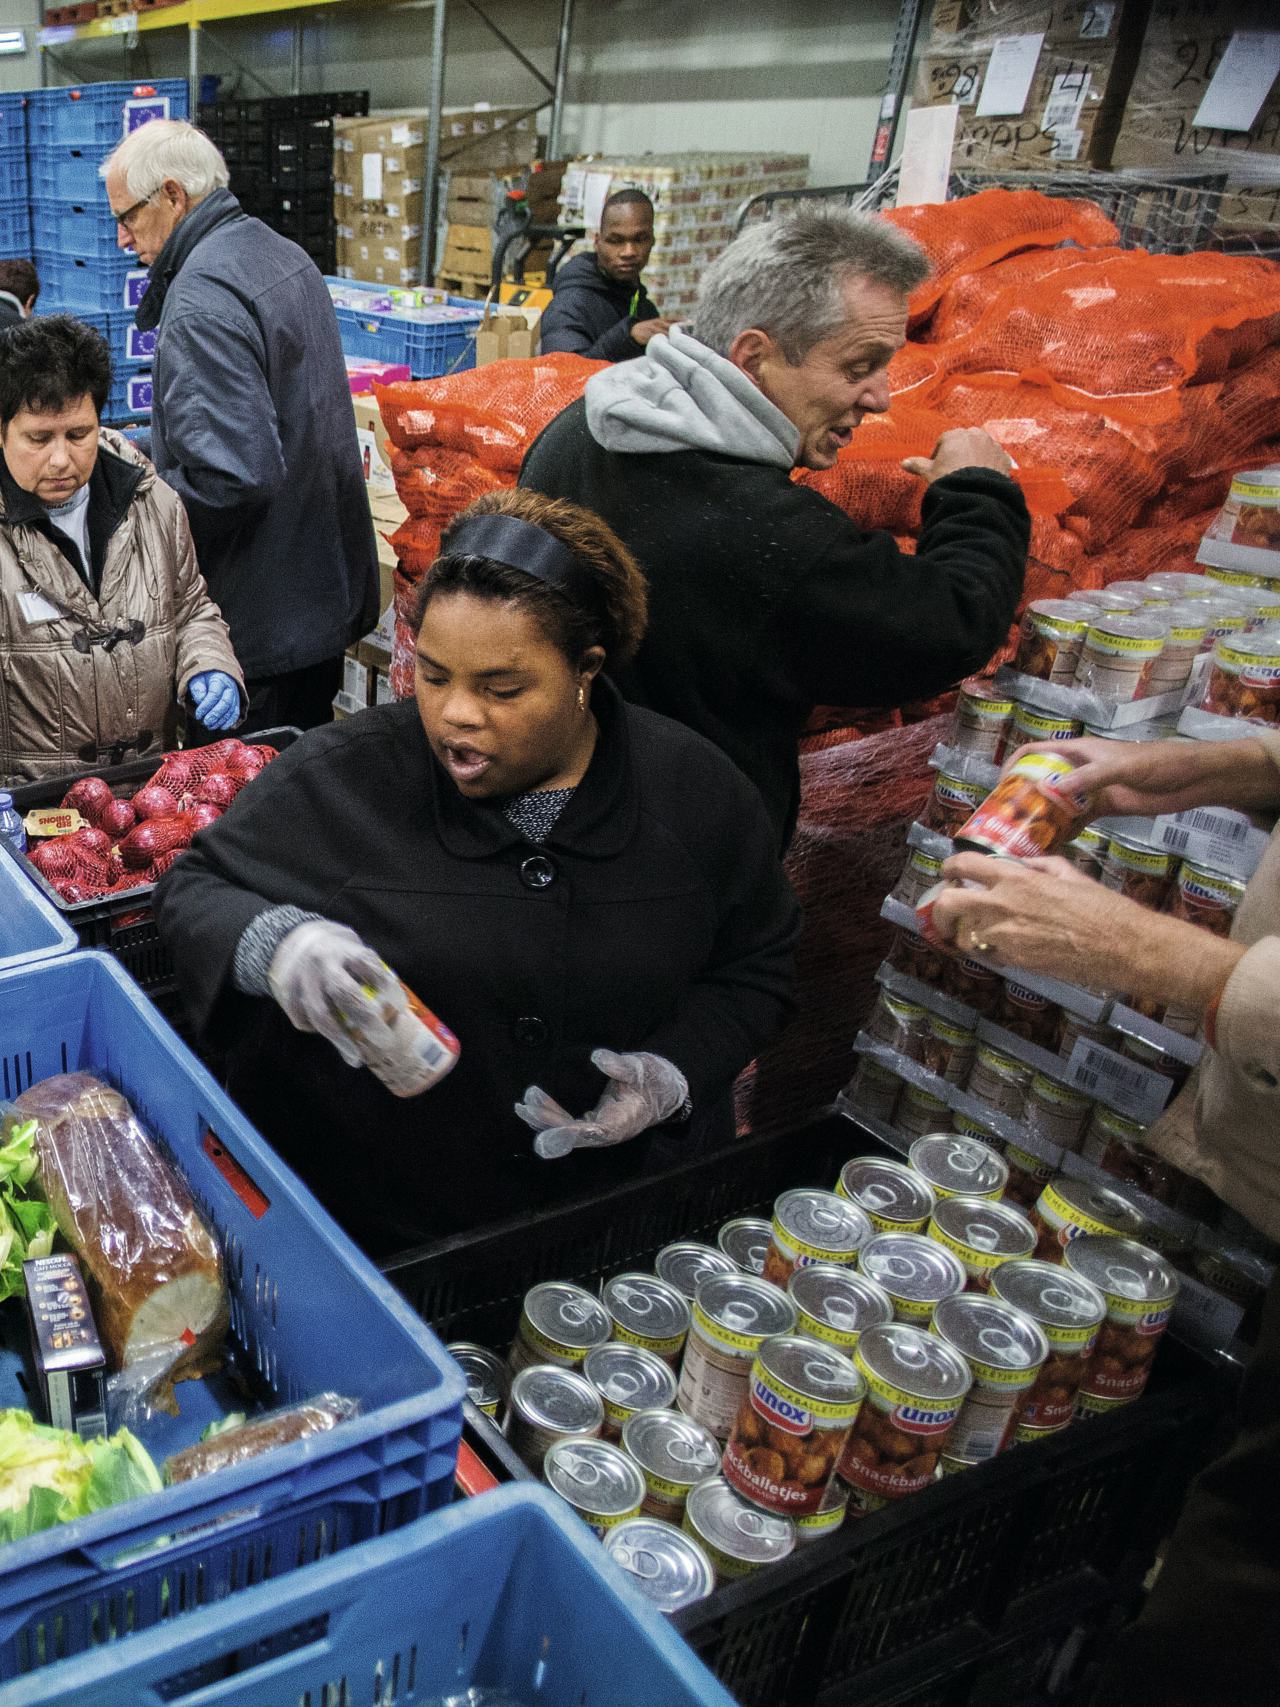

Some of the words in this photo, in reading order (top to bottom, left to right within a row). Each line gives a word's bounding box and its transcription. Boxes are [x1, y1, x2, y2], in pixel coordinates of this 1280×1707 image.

[38, 814, 72, 826] ONIONS
[56, 820, 72, 829] RED
[1010, 982, 1044, 1004] unox
[1053, 1199, 1067, 1214] MET
[1069, 1213, 1081, 1223] 20
[958, 1249, 979, 1263] MET
[872, 1379, 892, 1397] MET
[755, 1381, 807, 1424] unox
[901, 1406, 957, 1424] unox
[726, 1447, 808, 1502] ackballetjes
[851, 1456, 932, 1488] Snackball
[654, 1479, 675, 1492] MET
